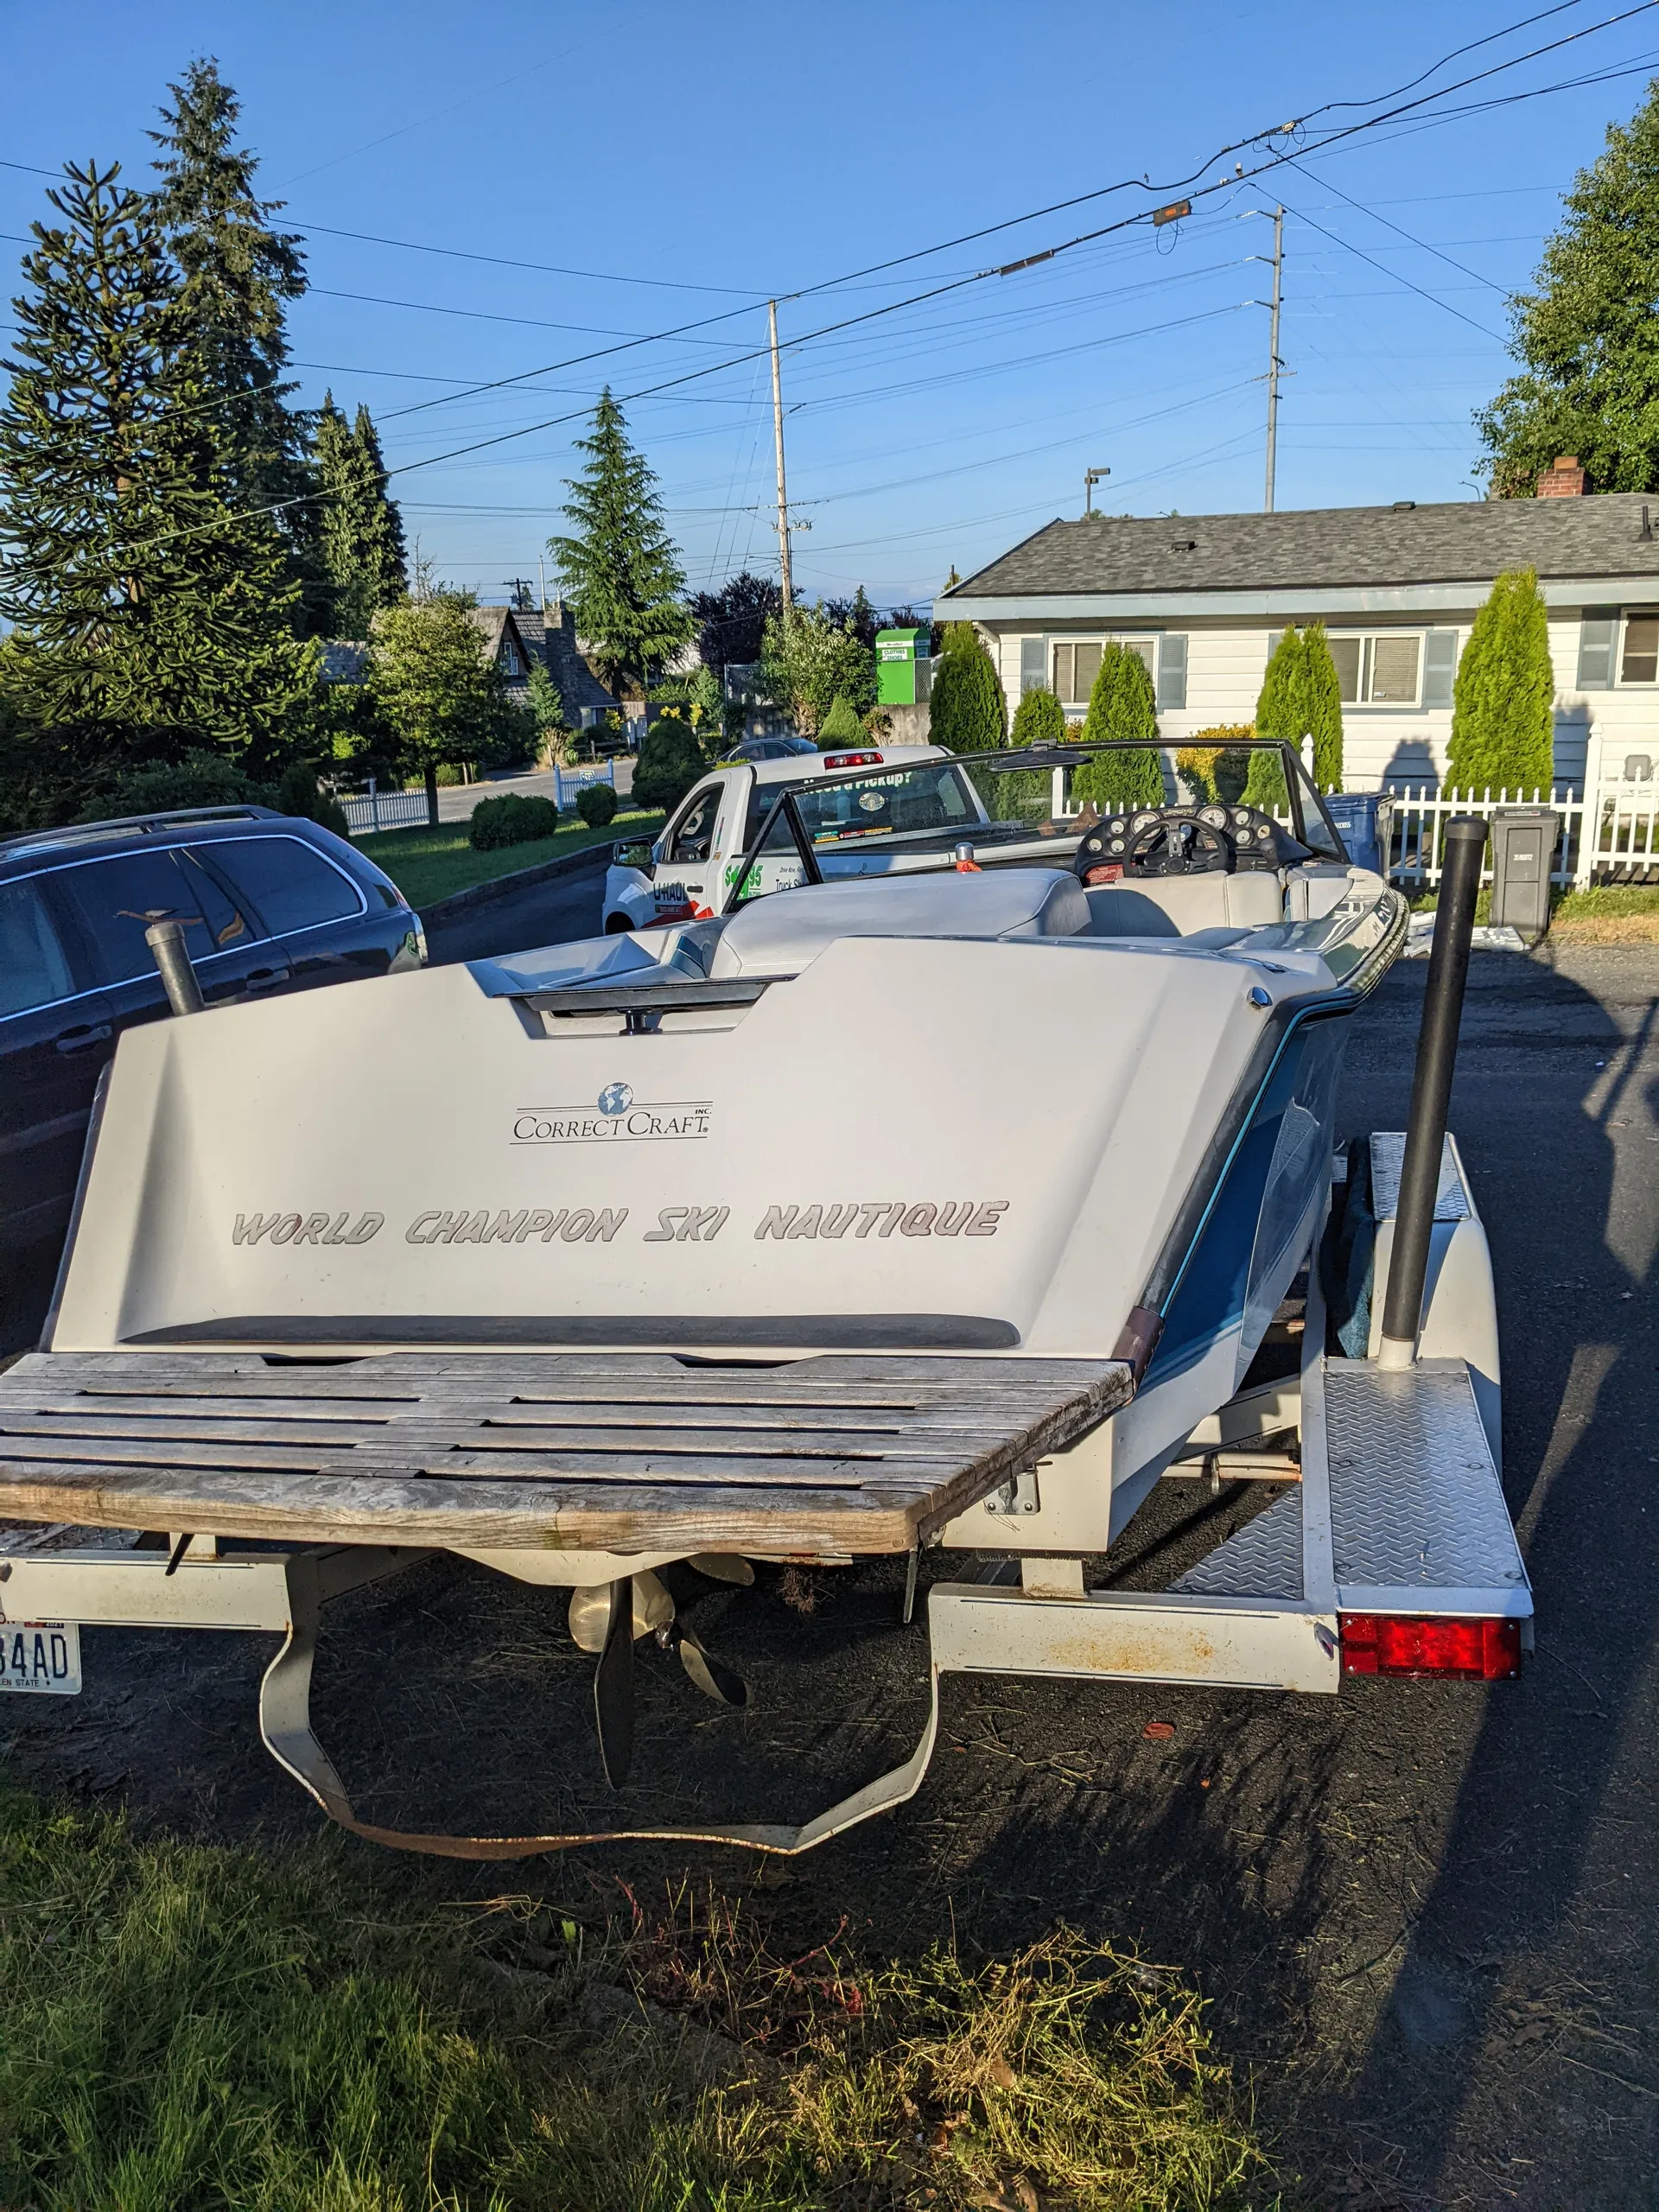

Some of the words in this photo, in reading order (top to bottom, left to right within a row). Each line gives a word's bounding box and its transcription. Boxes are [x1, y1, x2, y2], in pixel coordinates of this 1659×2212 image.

[855, 772, 912, 789] Pickup?
[513, 1116, 625, 1140] CORRECT
[626, 1111, 709, 1135] CRAFT
[231, 1211, 385, 1245] WORLD
[404, 1208, 629, 1243] CHAMPION
[642, 1206, 731, 1242] SKI
[753, 1201, 1010, 1239] NAUTIQUE
